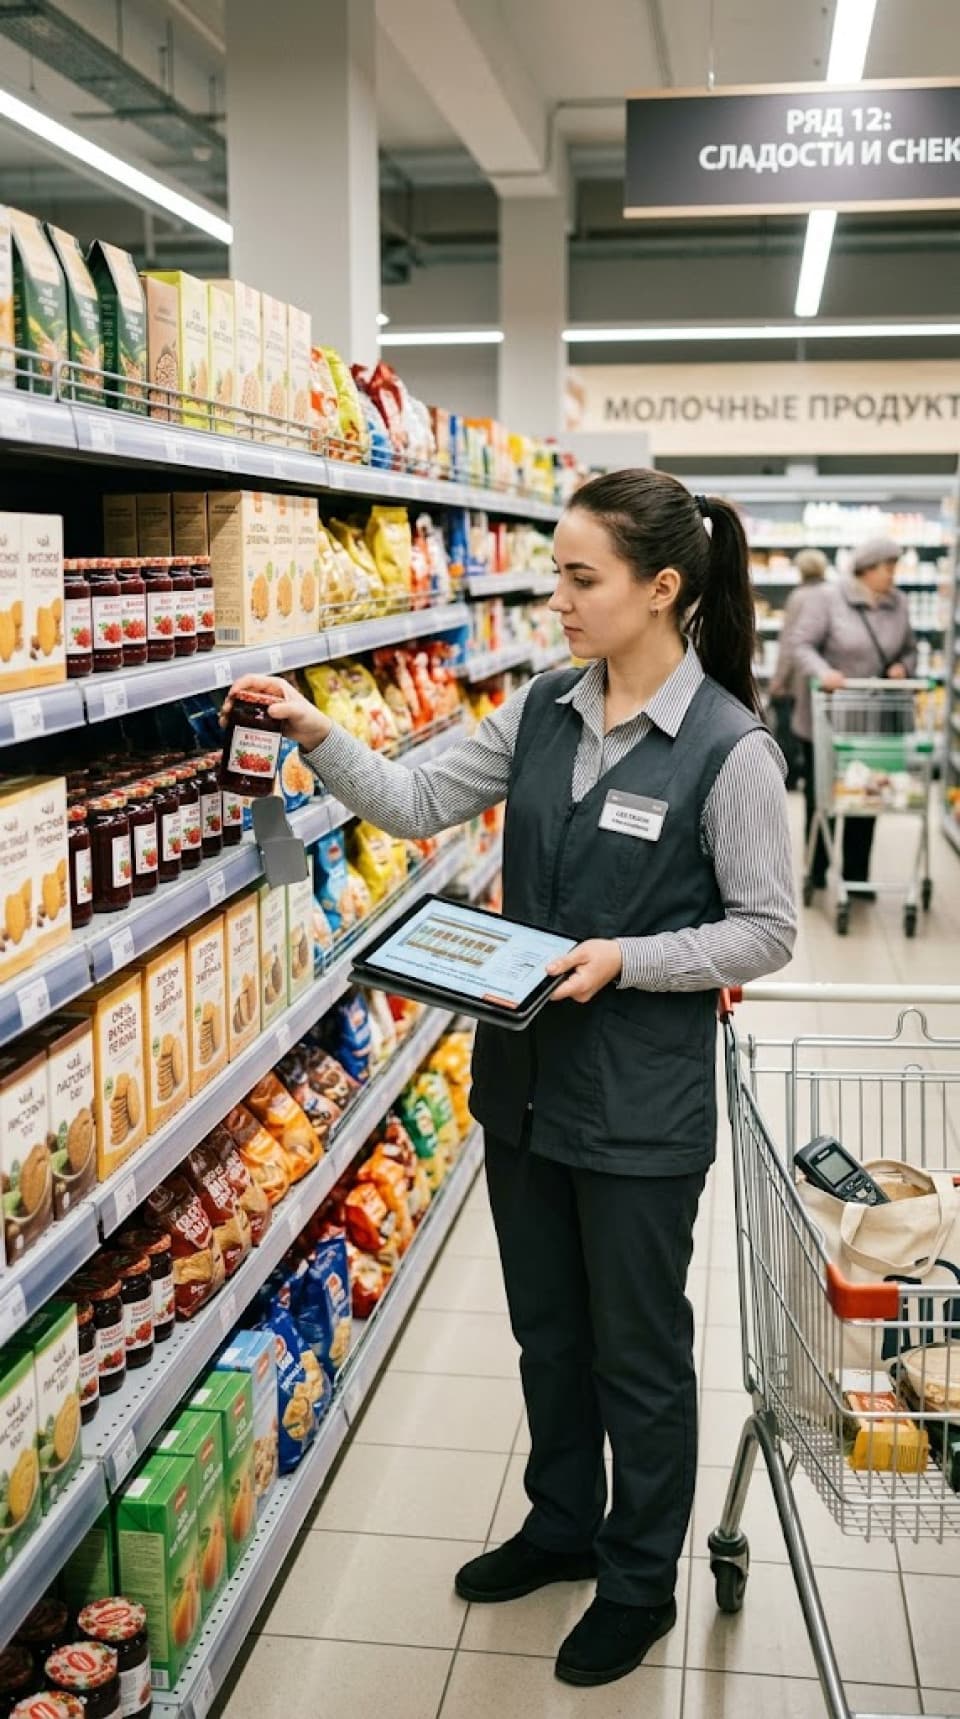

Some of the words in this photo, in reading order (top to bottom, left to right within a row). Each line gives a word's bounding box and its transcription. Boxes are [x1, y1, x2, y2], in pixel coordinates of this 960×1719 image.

[787, 108, 844, 137] РЯД
[852, 106, 892, 132] 12:
[699, 141, 854, 173] СЛАДОСТИ
[861, 140, 881, 165] И
[887, 136, 960, 164] СНЕК
[605, 396, 799, 421] МОЛОЧНЫЕ
[809, 393, 960, 424] ПРОДУКТ
